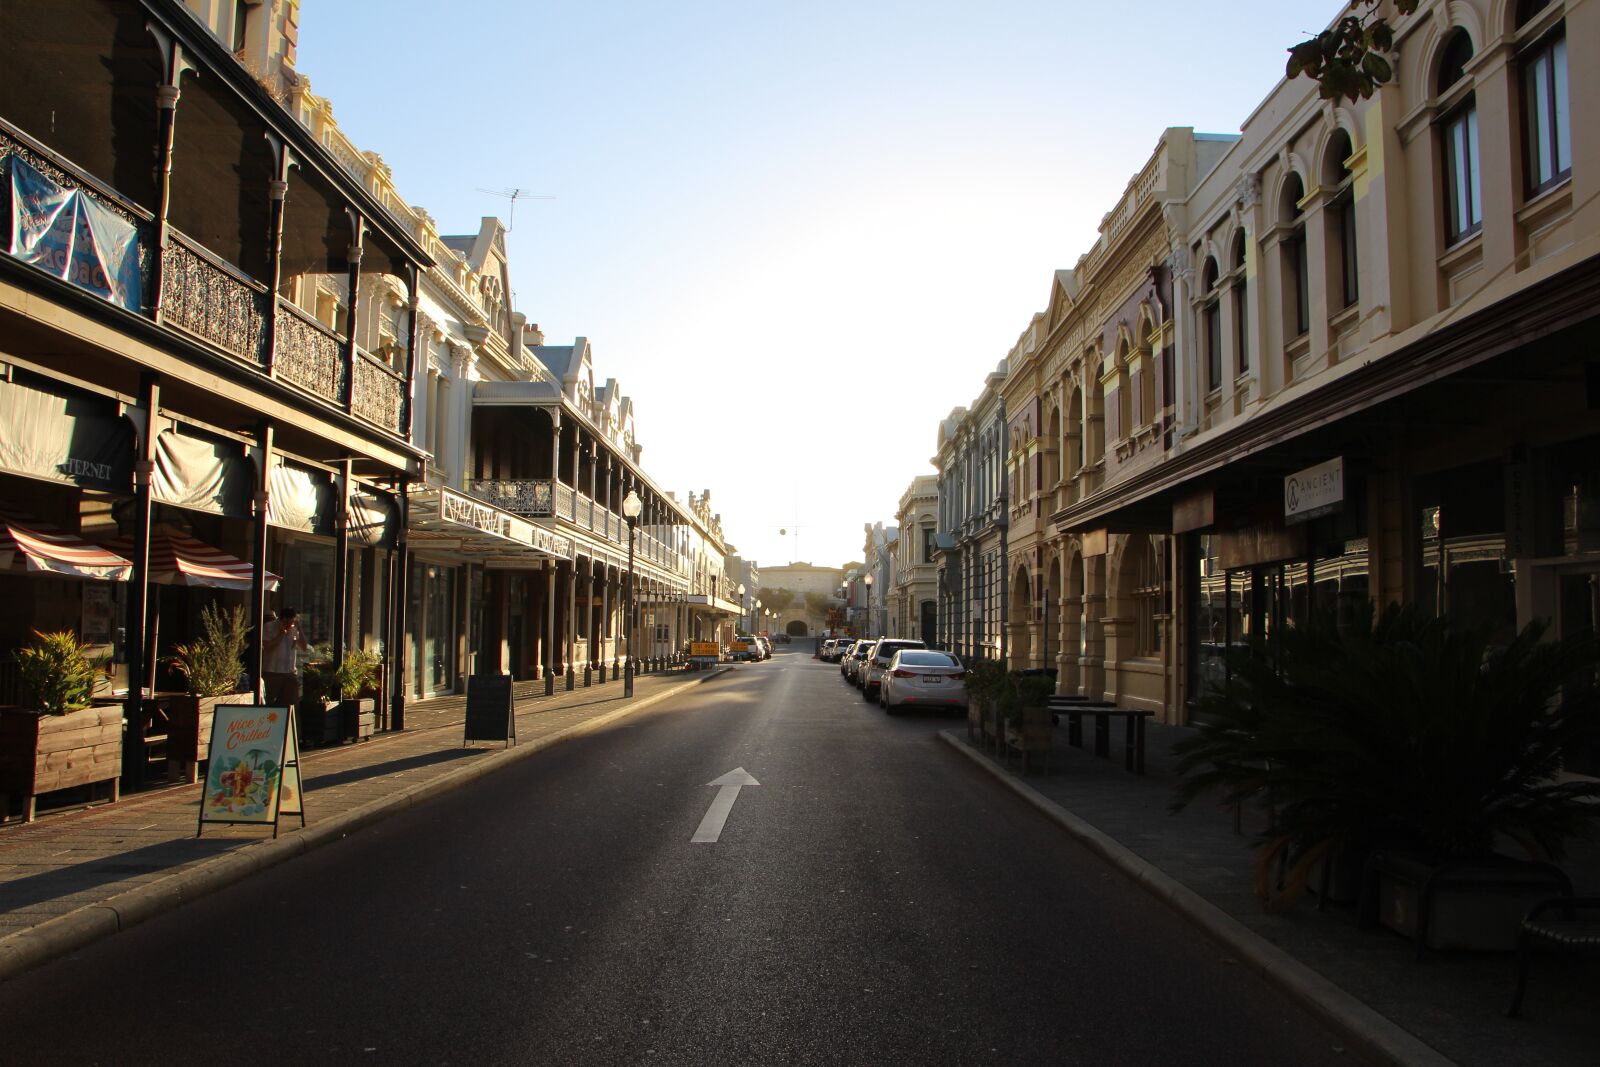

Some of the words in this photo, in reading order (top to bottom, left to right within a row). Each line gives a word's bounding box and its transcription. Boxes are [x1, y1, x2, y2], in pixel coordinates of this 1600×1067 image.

[1300, 469, 1340, 492] ANCIENT
[227, 719, 254, 733] Nice
[227, 727, 270, 749] Chilled
